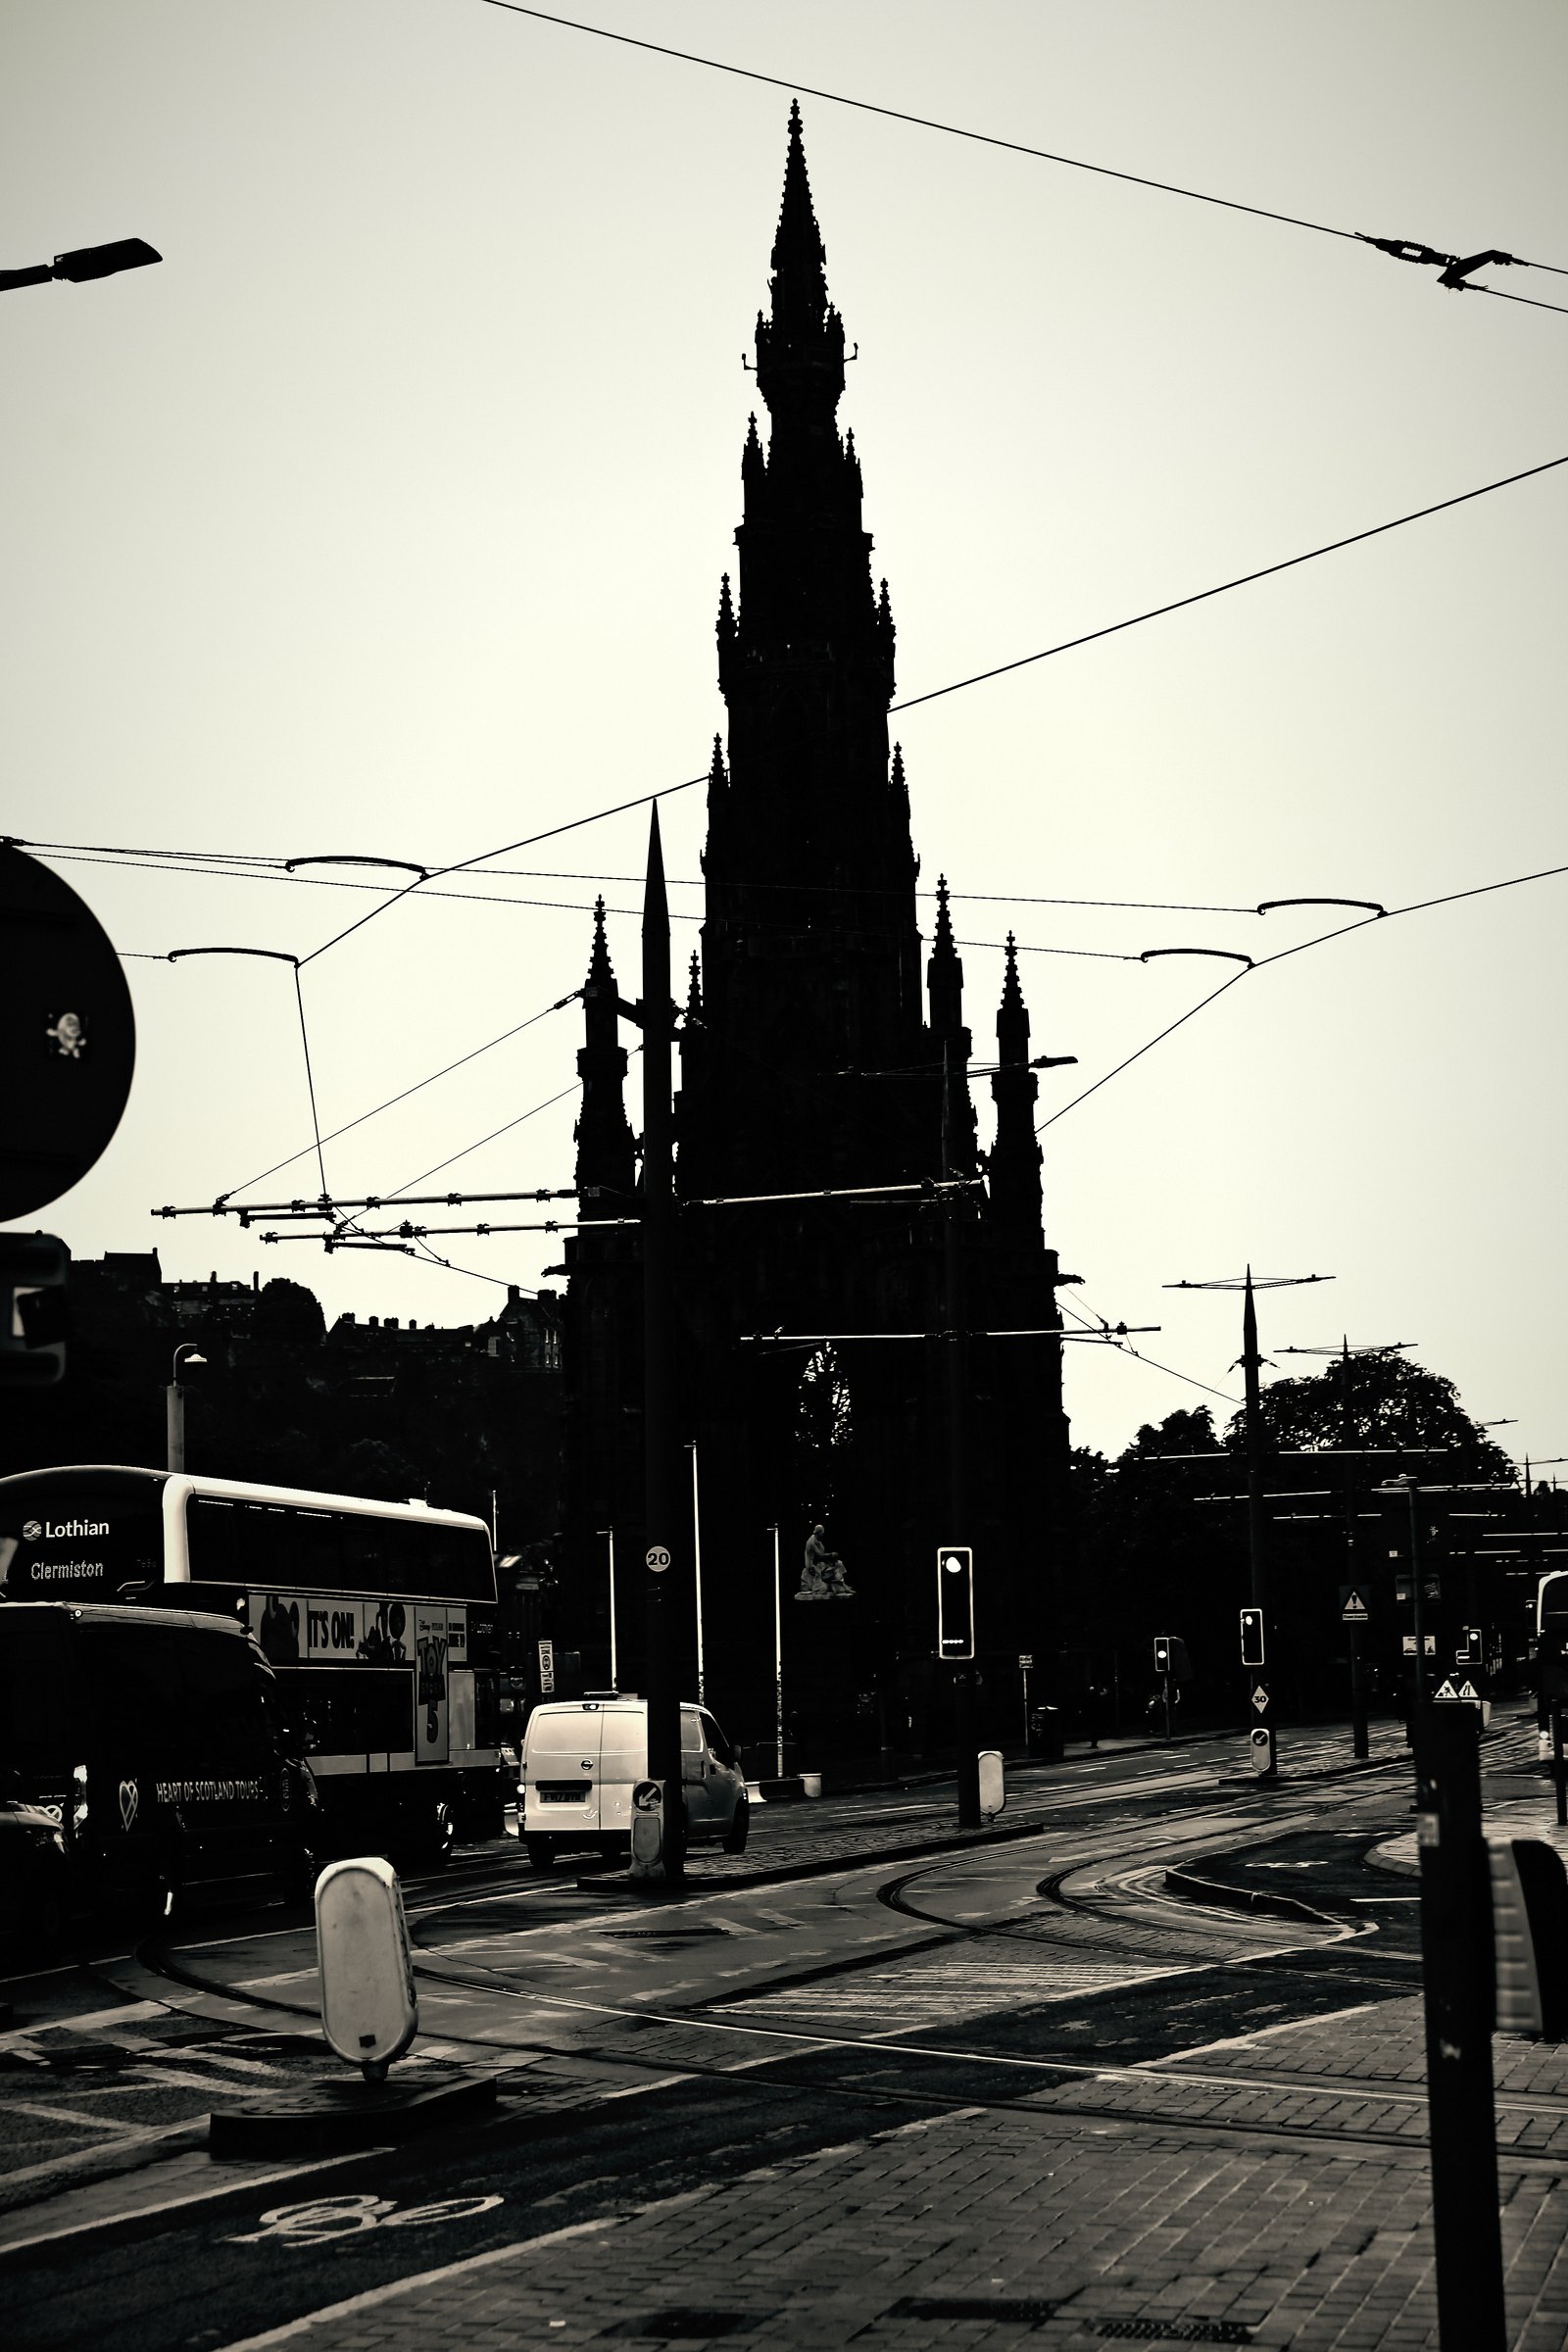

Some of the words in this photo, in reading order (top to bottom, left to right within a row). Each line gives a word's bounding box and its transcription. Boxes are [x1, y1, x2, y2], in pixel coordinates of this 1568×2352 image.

[45, 1519, 110, 1539] Lothian
[30, 1560, 104, 1580] Clermiston
[647, 1552, 669, 1565] 20
[308, 1610, 329, 1648] IT'S
[331, 1610, 355, 1649] ON!
[416, 1635, 448, 1678] TOY
[426, 1699, 439, 1744] 5
[156, 1782, 182, 1803] HEART
[183, 1781, 194, 1802] OF
[195, 1780, 235, 1801] SCOTLAND
[235, 1780, 259, 1800] TOURS
